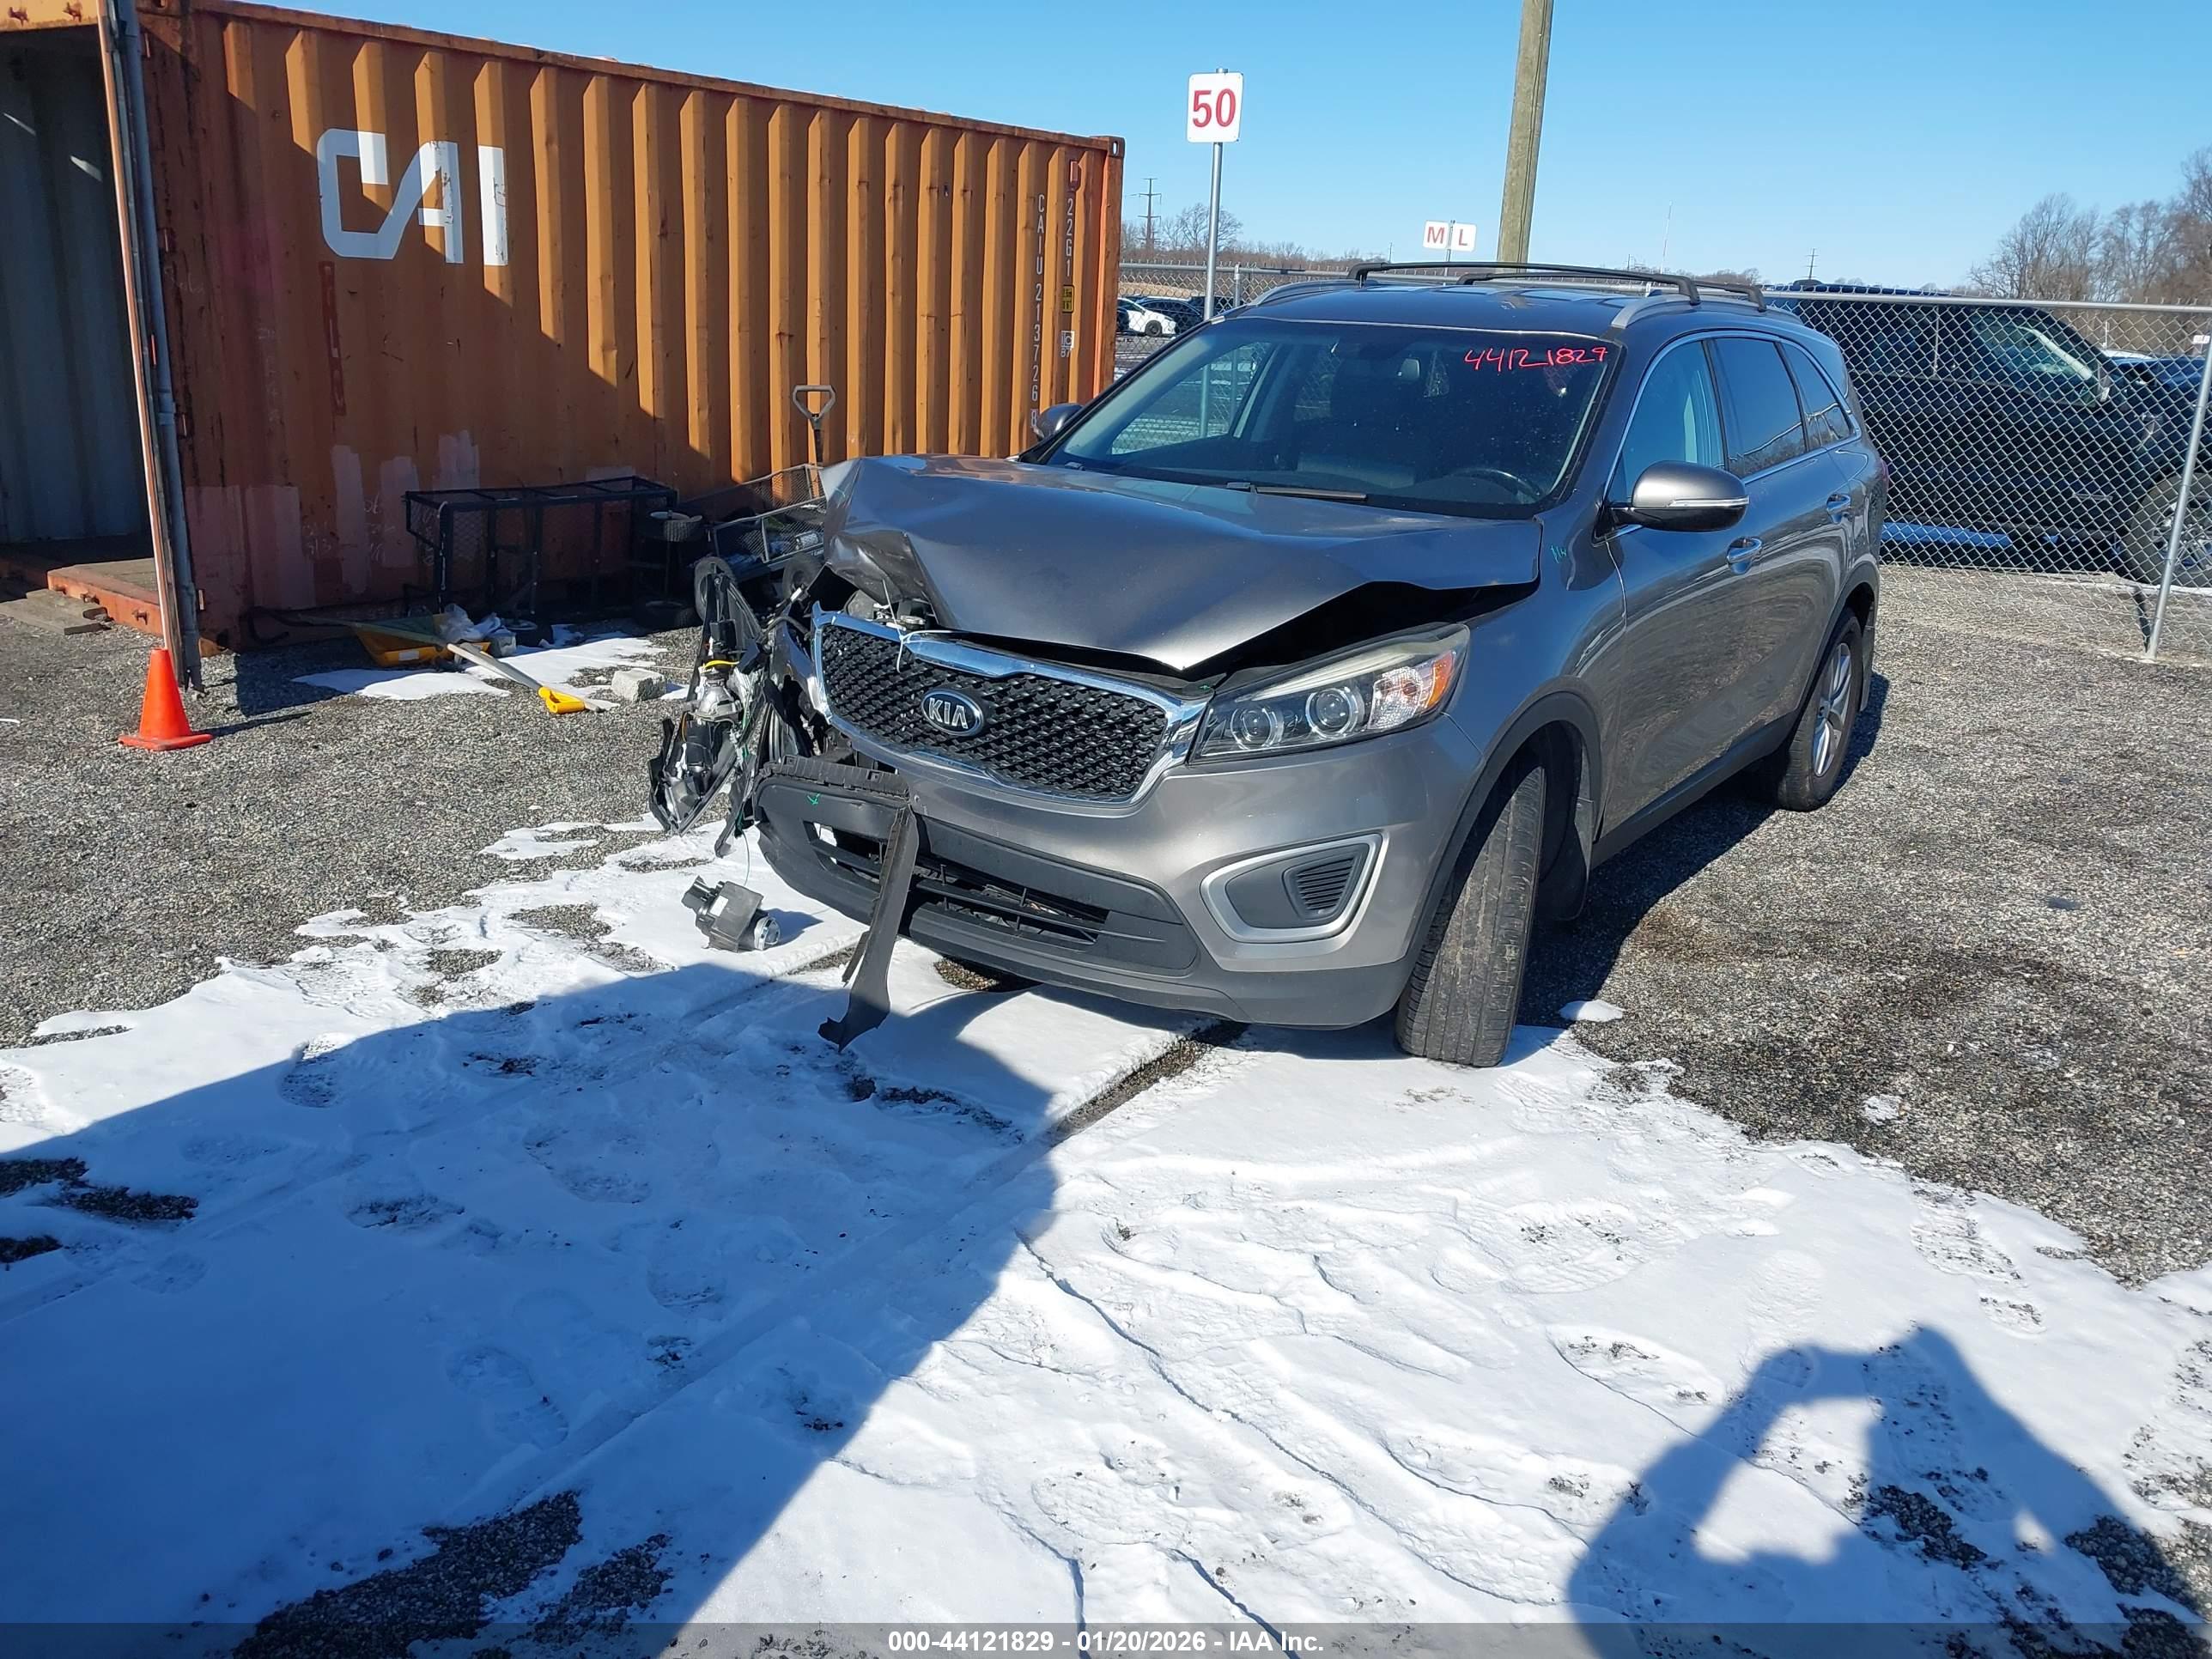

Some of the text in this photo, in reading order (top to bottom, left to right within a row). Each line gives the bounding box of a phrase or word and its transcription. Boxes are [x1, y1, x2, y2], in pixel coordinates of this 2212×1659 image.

[1193, 88, 1237, 128] 50
[316, 128, 508, 266] CAI
[1036, 194, 1045, 275] CAIU
[1427, 226, 1445, 244] M
[1458, 228, 1468, 246] L
[1031, 283, 1042, 402] 213726
[1464, 346, 1608, 373] 44121829
[928, 697, 969, 729] KIA
